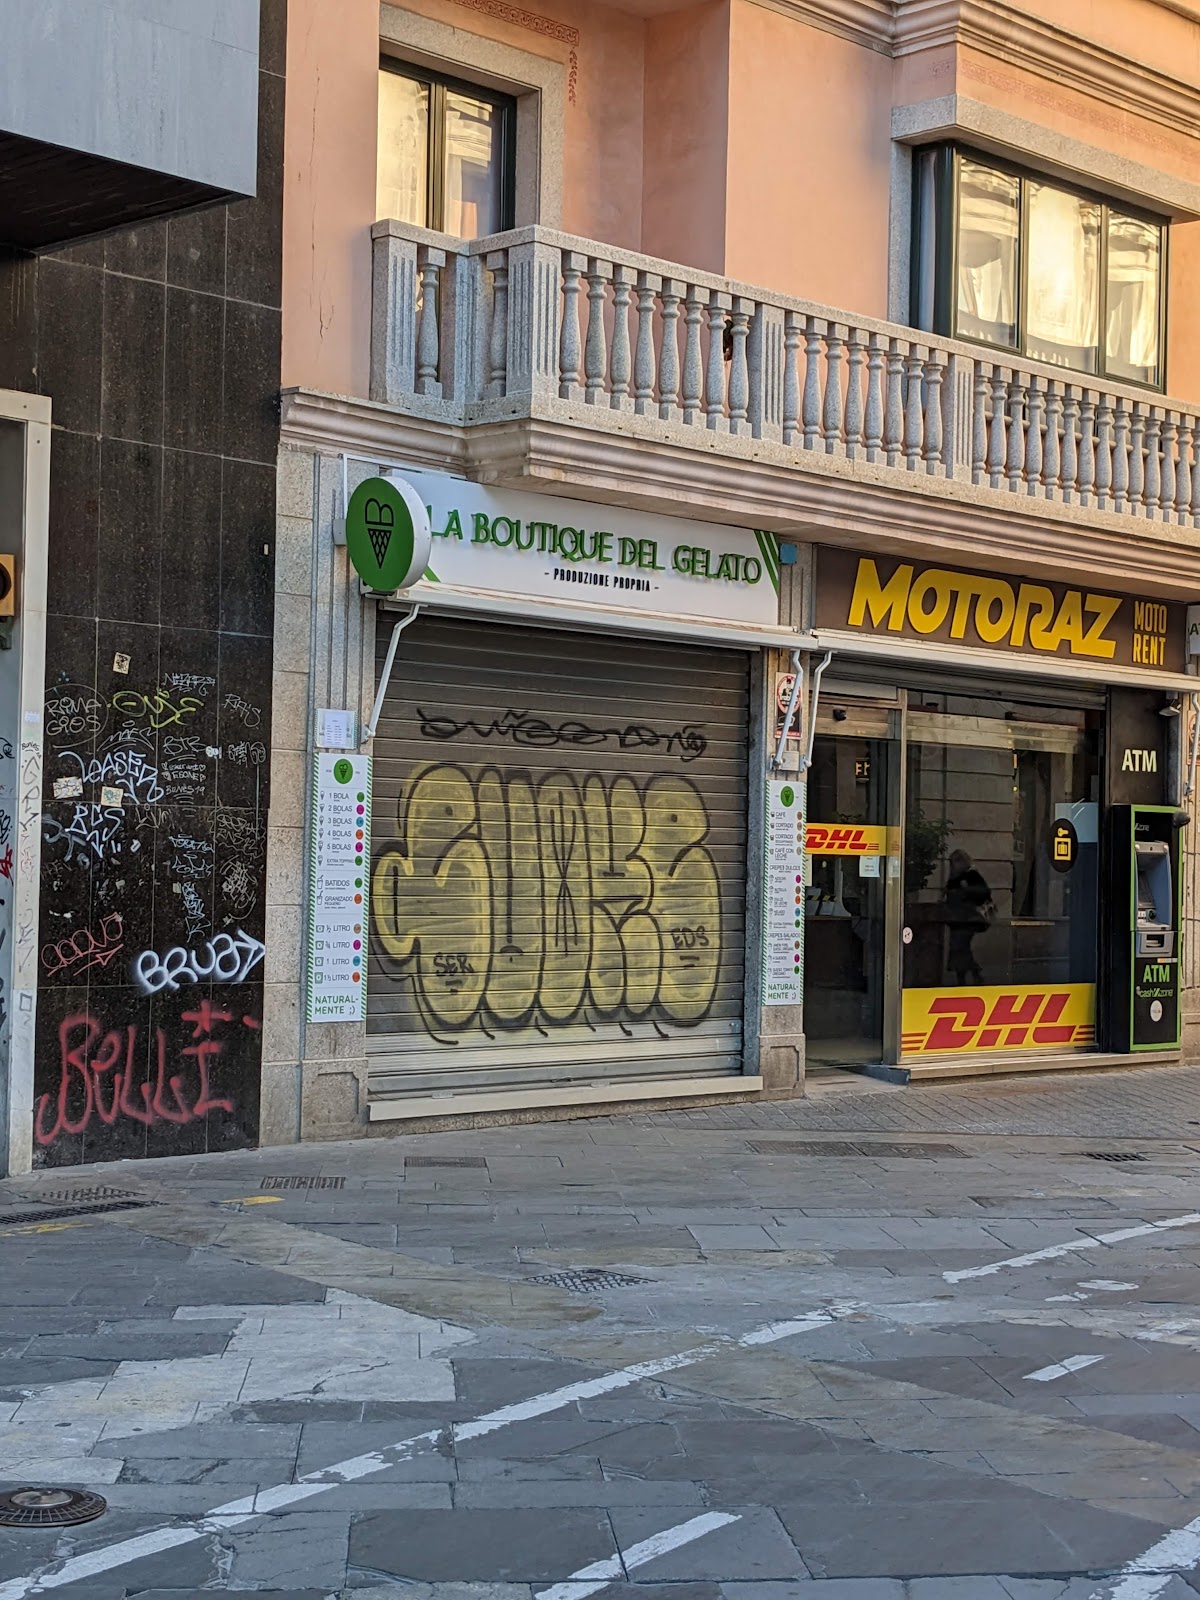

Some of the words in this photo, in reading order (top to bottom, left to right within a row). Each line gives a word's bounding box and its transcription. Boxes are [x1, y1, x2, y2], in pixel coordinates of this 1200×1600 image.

[425, 505, 463, 540] LA
[471, 513, 613, 562] BOUTIQUE
[618, 537, 666, 570] DEL
[672, 545, 762, 584] GELATO
[553, 567, 609, 587] PRODUZIONE
[613, 576, 650, 592] PROPRIA
[847, 557, 1123, 659] MOTORAZ
[1133, 600, 1167, 634] MOTO
[1189, 622, 1200, 636] A
[1132, 632, 1166, 666] RENT
[1121, 748, 1157, 773] ATM
[333, 792, 350, 800] BOLA
[328, 804, 332, 812] 2
[332, 817, 353, 825] BOLAS
[805, 828, 868, 850] DHL
[325, 879, 350, 887] BATIDOS
[333, 924, 351, 932] LITRO
[332, 941, 350, 949] LITRO
[1143, 964, 1170, 983] ATM
[315, 995, 359, 1005] NATURAL-
[768, 991, 789, 1000] MENTE
[315, 1005, 345, 1015] MENTE
[923, 993, 1077, 1050] DHL
